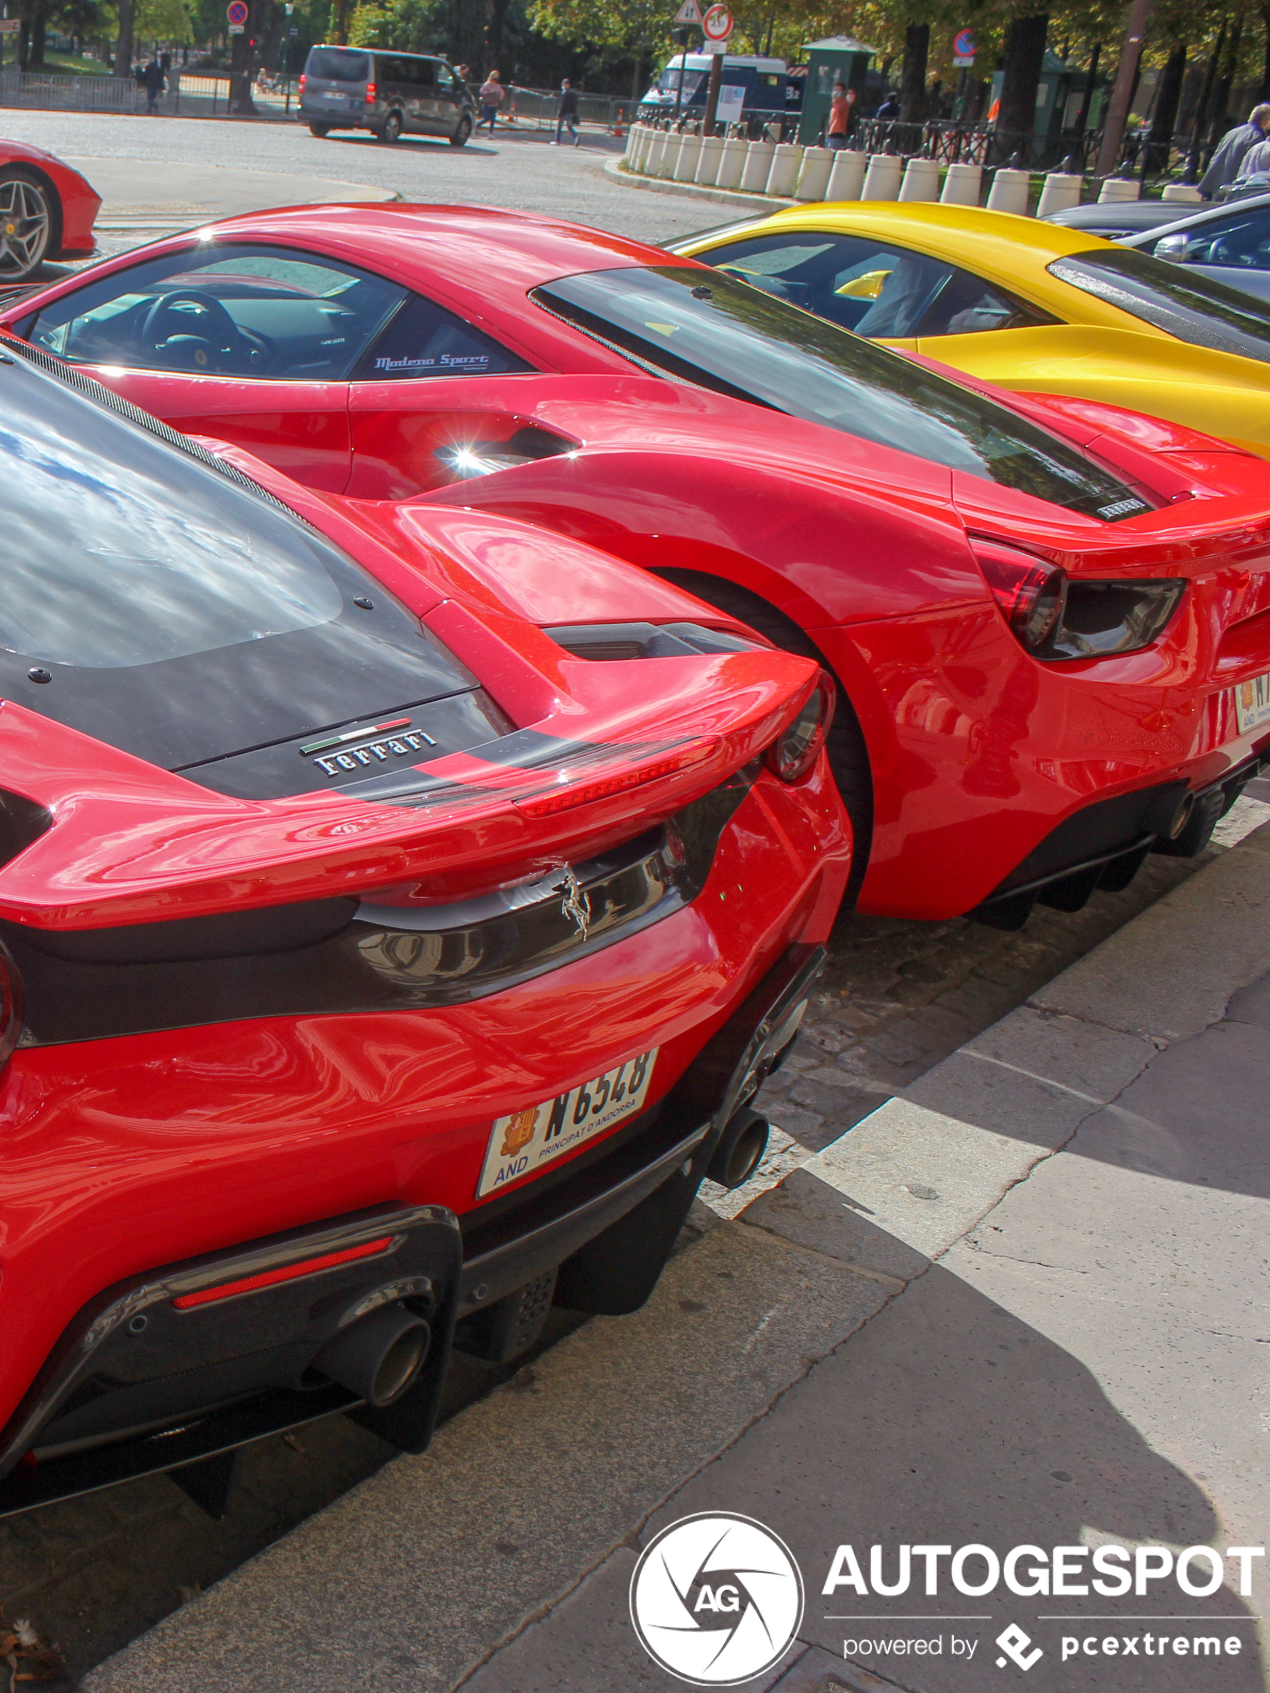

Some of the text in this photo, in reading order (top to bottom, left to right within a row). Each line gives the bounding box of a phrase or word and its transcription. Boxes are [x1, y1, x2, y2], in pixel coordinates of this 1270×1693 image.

[374, 354, 489, 371] Modena Sport
[314, 729, 438, 776] Ferrari
[573, 1050, 650, 1125] 6548
[538, 1098, 636, 1159] PRINCIPAT D'ANDORRA
[493, 1155, 529, 1186] AND
